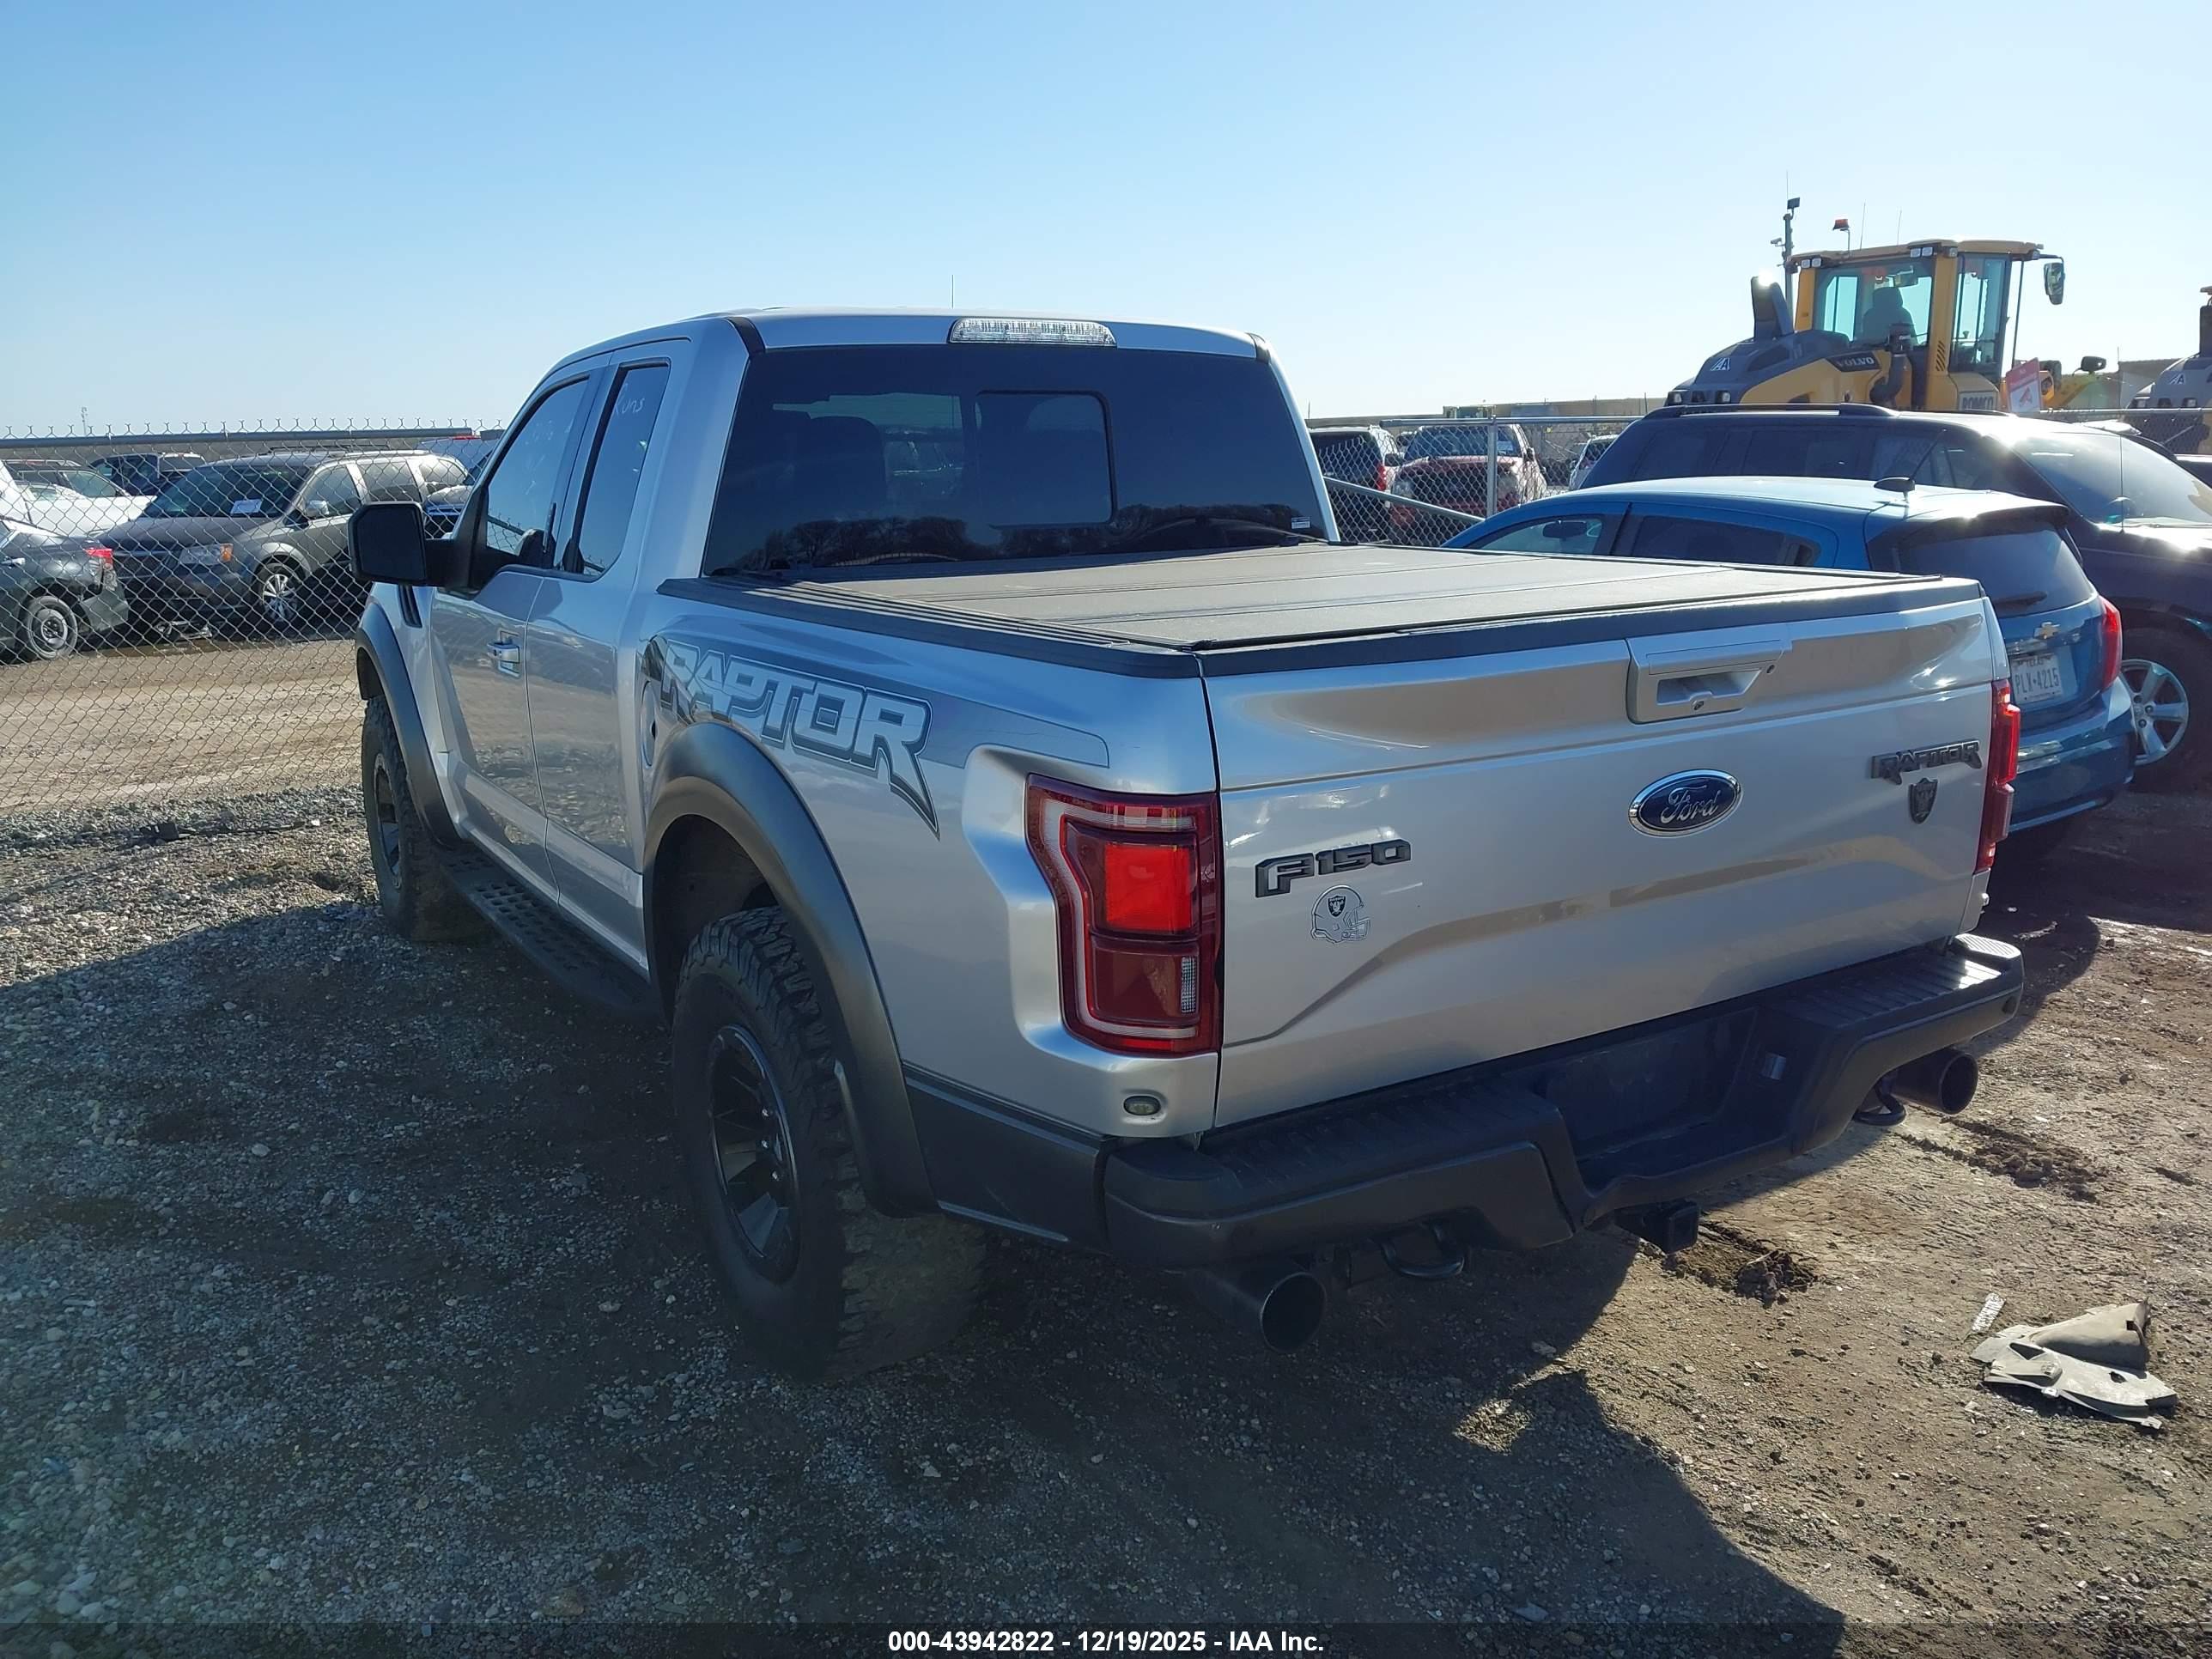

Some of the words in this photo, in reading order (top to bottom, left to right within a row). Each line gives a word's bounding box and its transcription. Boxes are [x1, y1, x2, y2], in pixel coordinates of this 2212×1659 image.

[1836, 356, 1875, 368] VOLVO
[660, 639, 940, 842] RAPTOR
[1870, 739, 1983, 786] RAPTOR
[1660, 785, 1721, 824] Ford
